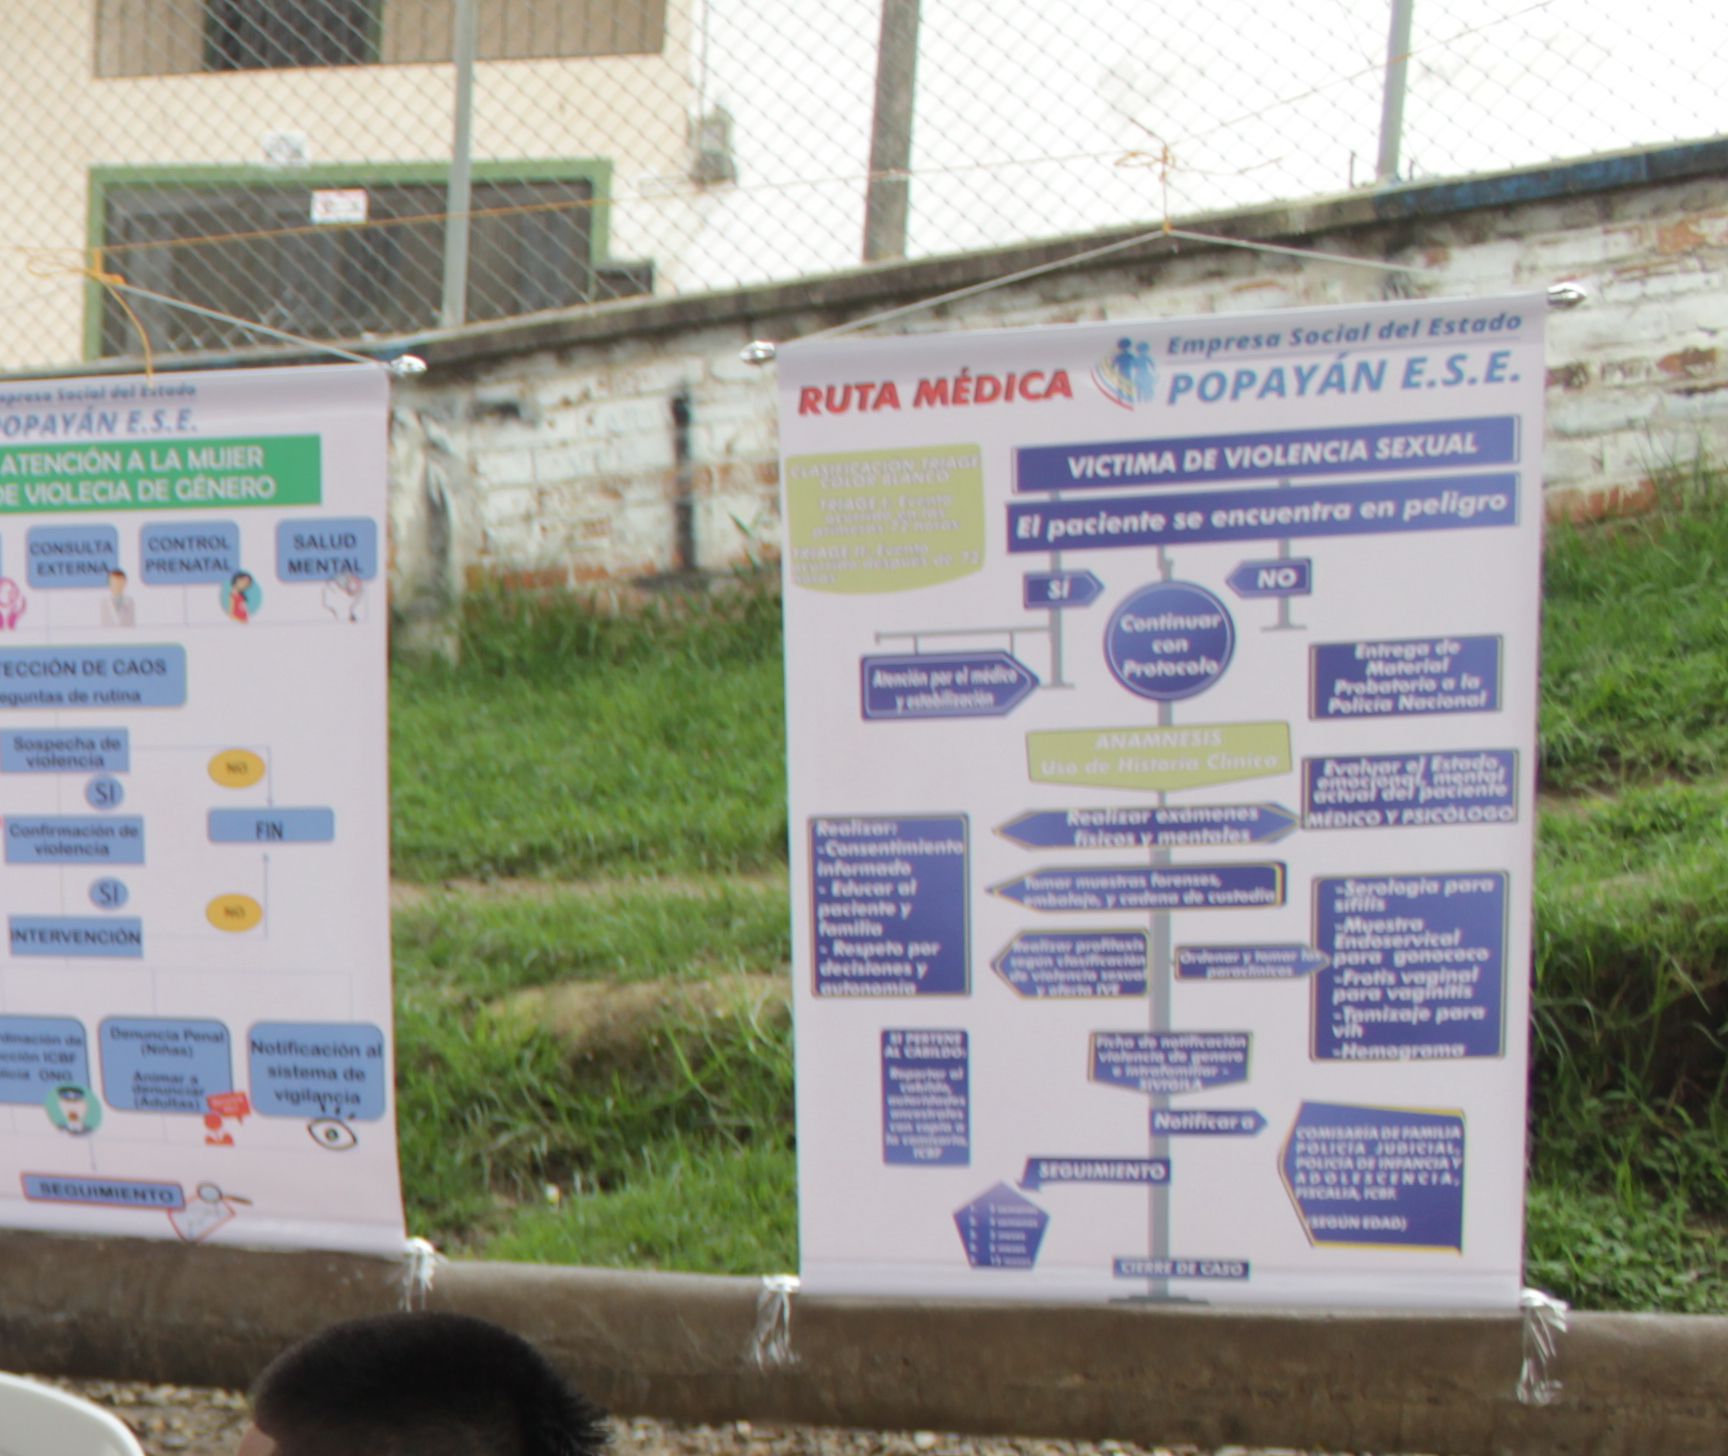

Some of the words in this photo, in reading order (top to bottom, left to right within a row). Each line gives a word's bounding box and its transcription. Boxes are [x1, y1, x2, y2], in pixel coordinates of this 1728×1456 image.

[1166, 331, 1280, 357] Empresa
[1289, 324, 1368, 348] Social
[1379, 319, 1421, 342] del
[1428, 312, 1522, 339] Estado
[1167, 352, 1384, 406] POPAYÁN
[1402, 350, 1522, 390] E.S.E.
[797, 383, 900, 416] RUTA
[913, 367, 1074, 412] MÉDICA
[126, 407, 197, 433] E.S.E.
[1, 447, 121, 476] ATENCIÓN
[127, 450, 144, 471] A
[151, 450, 181, 471] LA
[188, 445, 263, 469] MUJER
[1068, 454, 1176, 479] VICTIMA
[1184, 448, 1217, 472] DE
[1224, 440, 1367, 469] VIOLENCIA
[1376, 433, 1479, 460] SEXUAL
[25, 480, 131, 505] VIOLECIA
[138, 479, 169, 500] DE
[175, 474, 275, 500] GÉNERO
[1016, 515, 1040, 539] El
[1047, 511, 1166, 542] paciente
[1173, 509, 1204, 529] se
[1211, 501, 1351, 528] encuentra
[1360, 498, 1395, 519] en
[1403, 491, 1508, 521] peligro
[29, 541, 113, 557] CONSULTA
[148, 536, 229, 551] CONTROL
[294, 533, 357, 550] SALUD
[37, 561, 109, 576] EXTERNA
[146, 558, 230, 574] PRENATAL
[288, 559, 362, 575] MENTAL
[1257, 569, 1297, 589] NO
[1120, 613, 1221, 633] Continuar
[1152, 638, 1188, 653] con
[1355, 641, 1429, 661] Entrega
[1436, 639, 1460, 654] de
[82, 660, 110, 677] DE
[113, 658, 167, 676] CAOS
[1122, 657, 1219, 678] Protocolo
[1366, 658, 1450, 676] Material
[874, 668, 927, 688] Atención
[930, 671, 952, 691] por
[1334, 677, 1436, 696] Probatorio
[1442, 676, 1454, 689] a
[1461, 673, 1480, 689] la
[68, 689, 88, 703] de
[93, 689, 141, 704] rutina
[1399, 692, 1486, 711] Nacional
[14, 736, 99, 753] Sospecha
[104, 737, 121, 750] de
[26, 754, 104, 768] violencia
[1309, 808, 1381, 828] MÉDICO
[1402, 805, 1514, 824] PSICÓLOGO
[9, 823, 114, 839] Confirmación
[120, 825, 138, 838] de
[256, 820, 283, 840] FIN
[35, 842, 109, 857] violencia
[10, 926, 140, 945] INTERVENCIÓN
[251, 1040, 361, 1057] Notificación
[365, 1042, 382, 1057] al
[268, 1065, 336, 1081] sistema
[343, 1067, 365, 1082] de
[274, 1087, 360, 1106] vigilancia
[1155, 1112, 1237, 1130] Notificar
[1039, 1162, 1165, 1179] SEGUIMIENTO
[39, 1181, 174, 1203] SEGUIMIENTO
